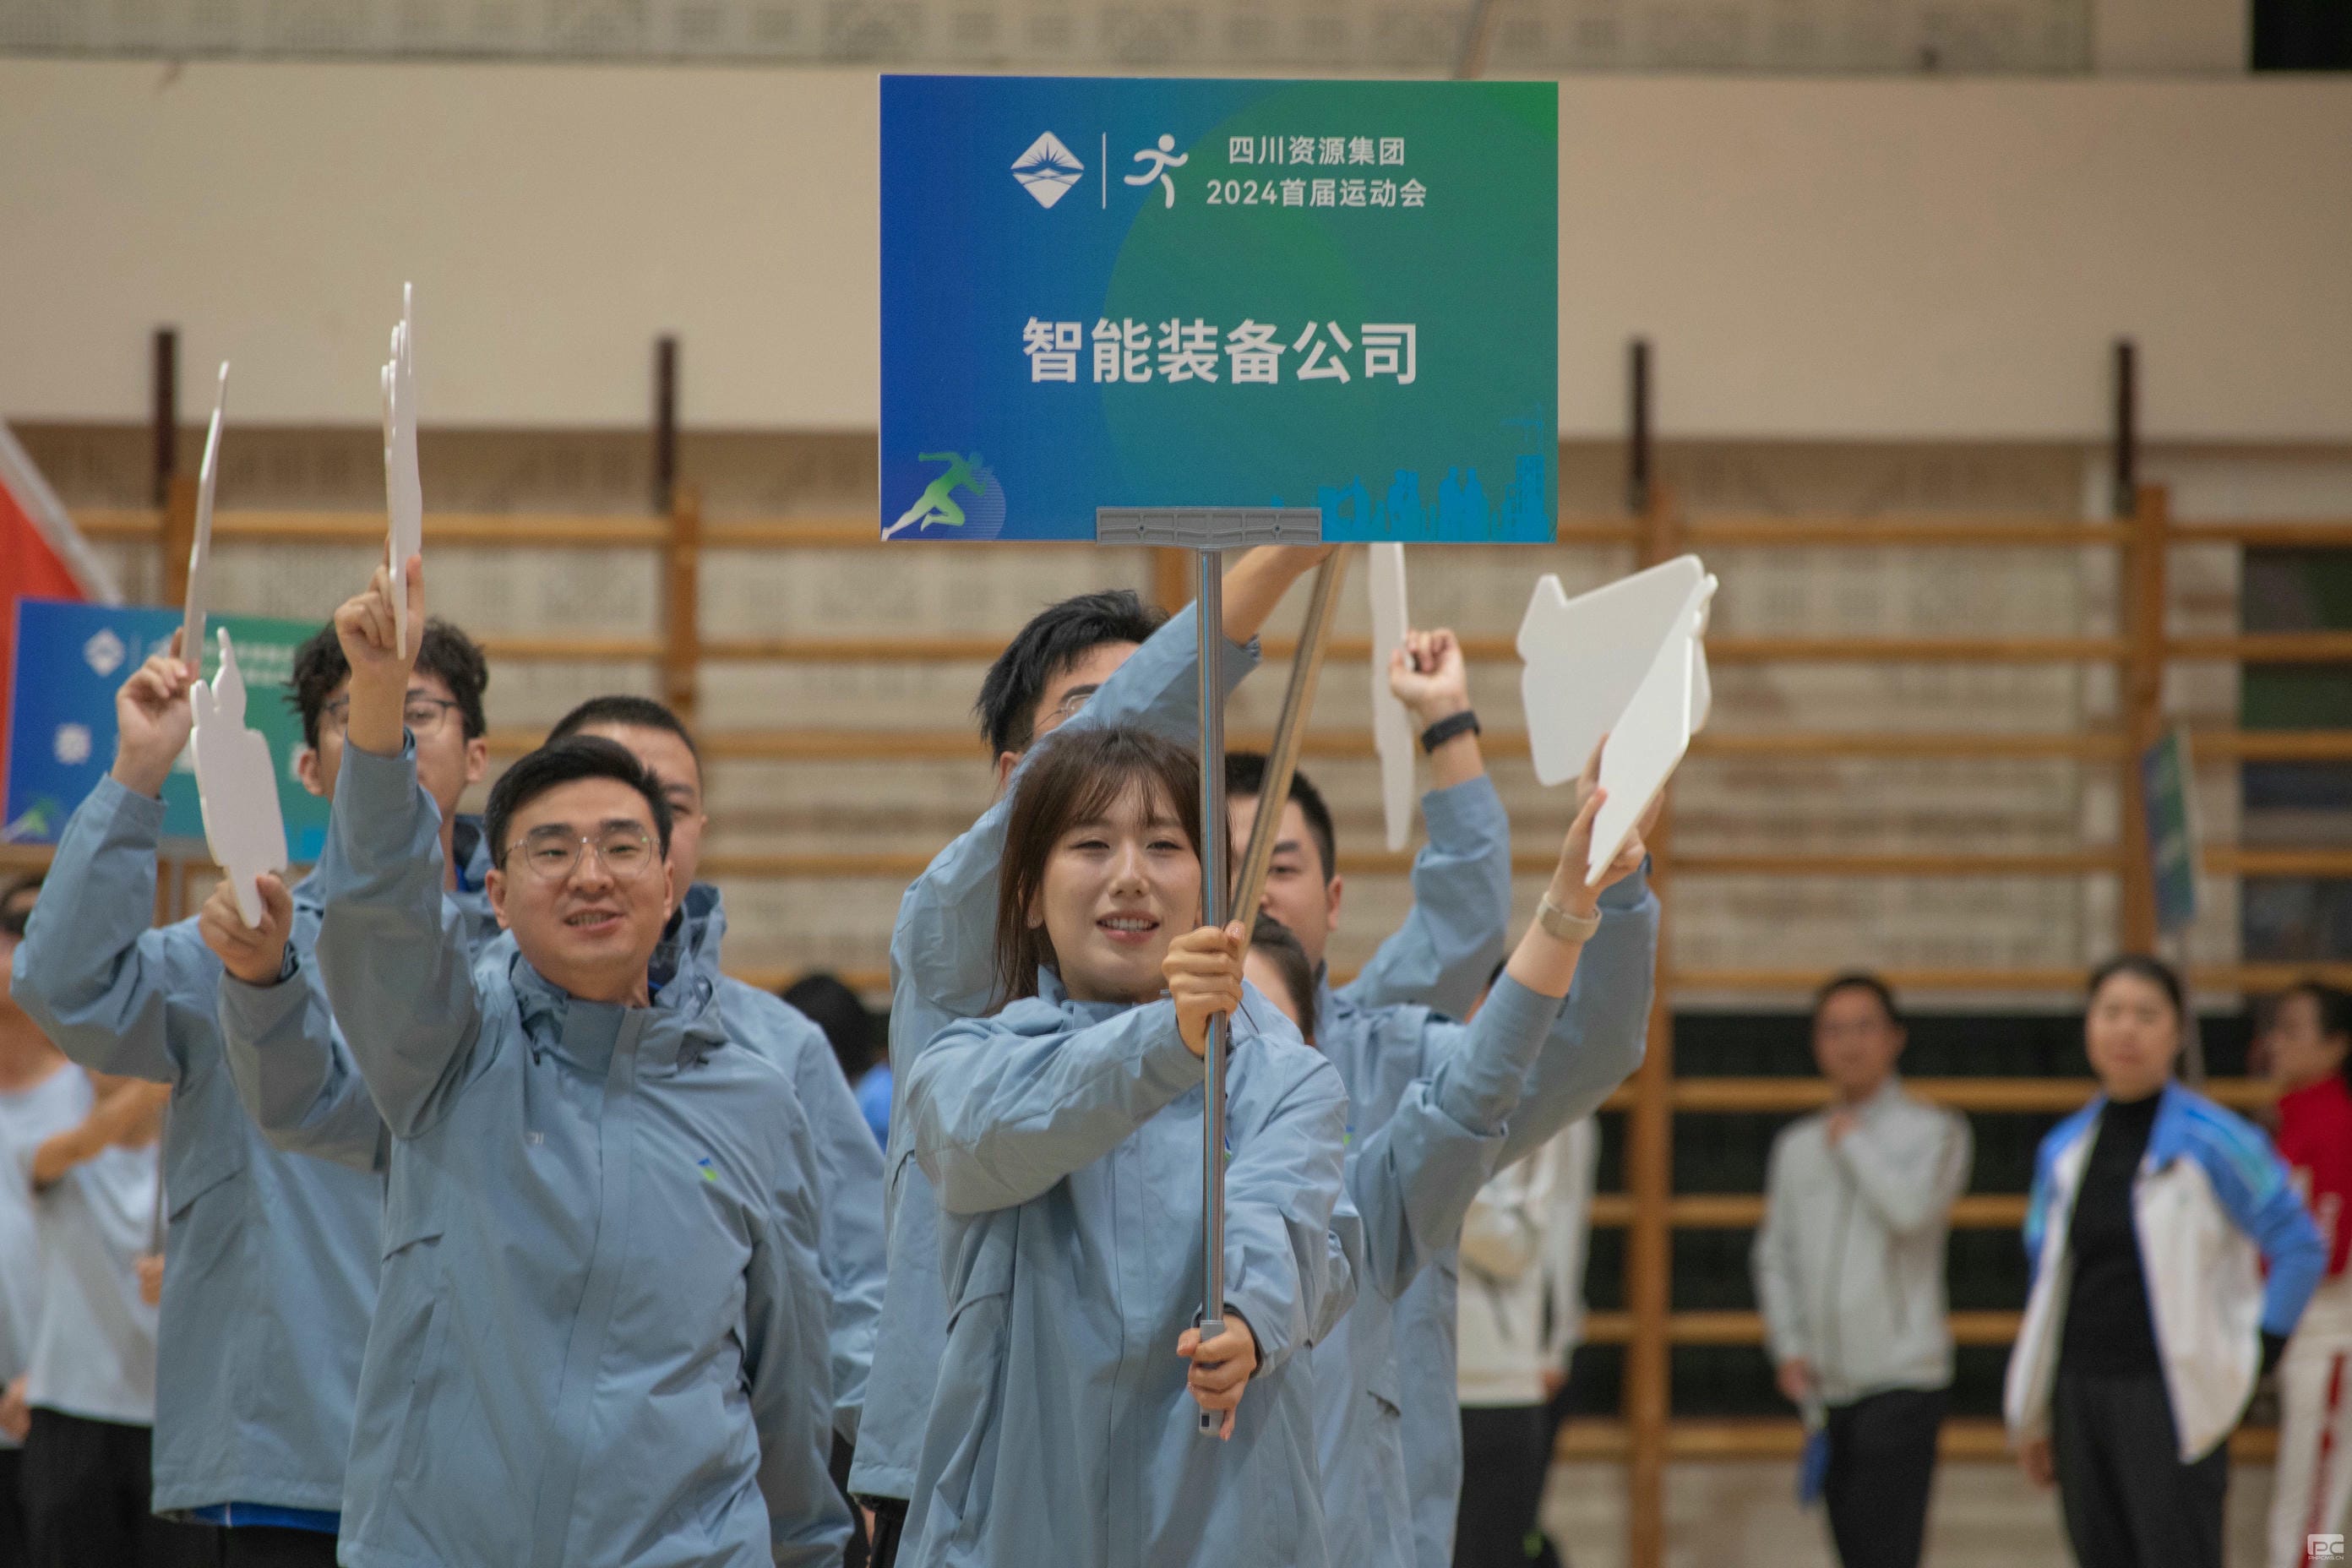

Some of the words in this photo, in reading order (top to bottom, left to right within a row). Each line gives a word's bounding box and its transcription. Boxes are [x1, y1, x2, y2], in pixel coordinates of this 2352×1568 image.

[1228, 135, 1406, 166] 四川资源集团
[1206, 177, 1428, 208] 2024首届运动会
[1021, 317, 1418, 385] 智能装备公司
